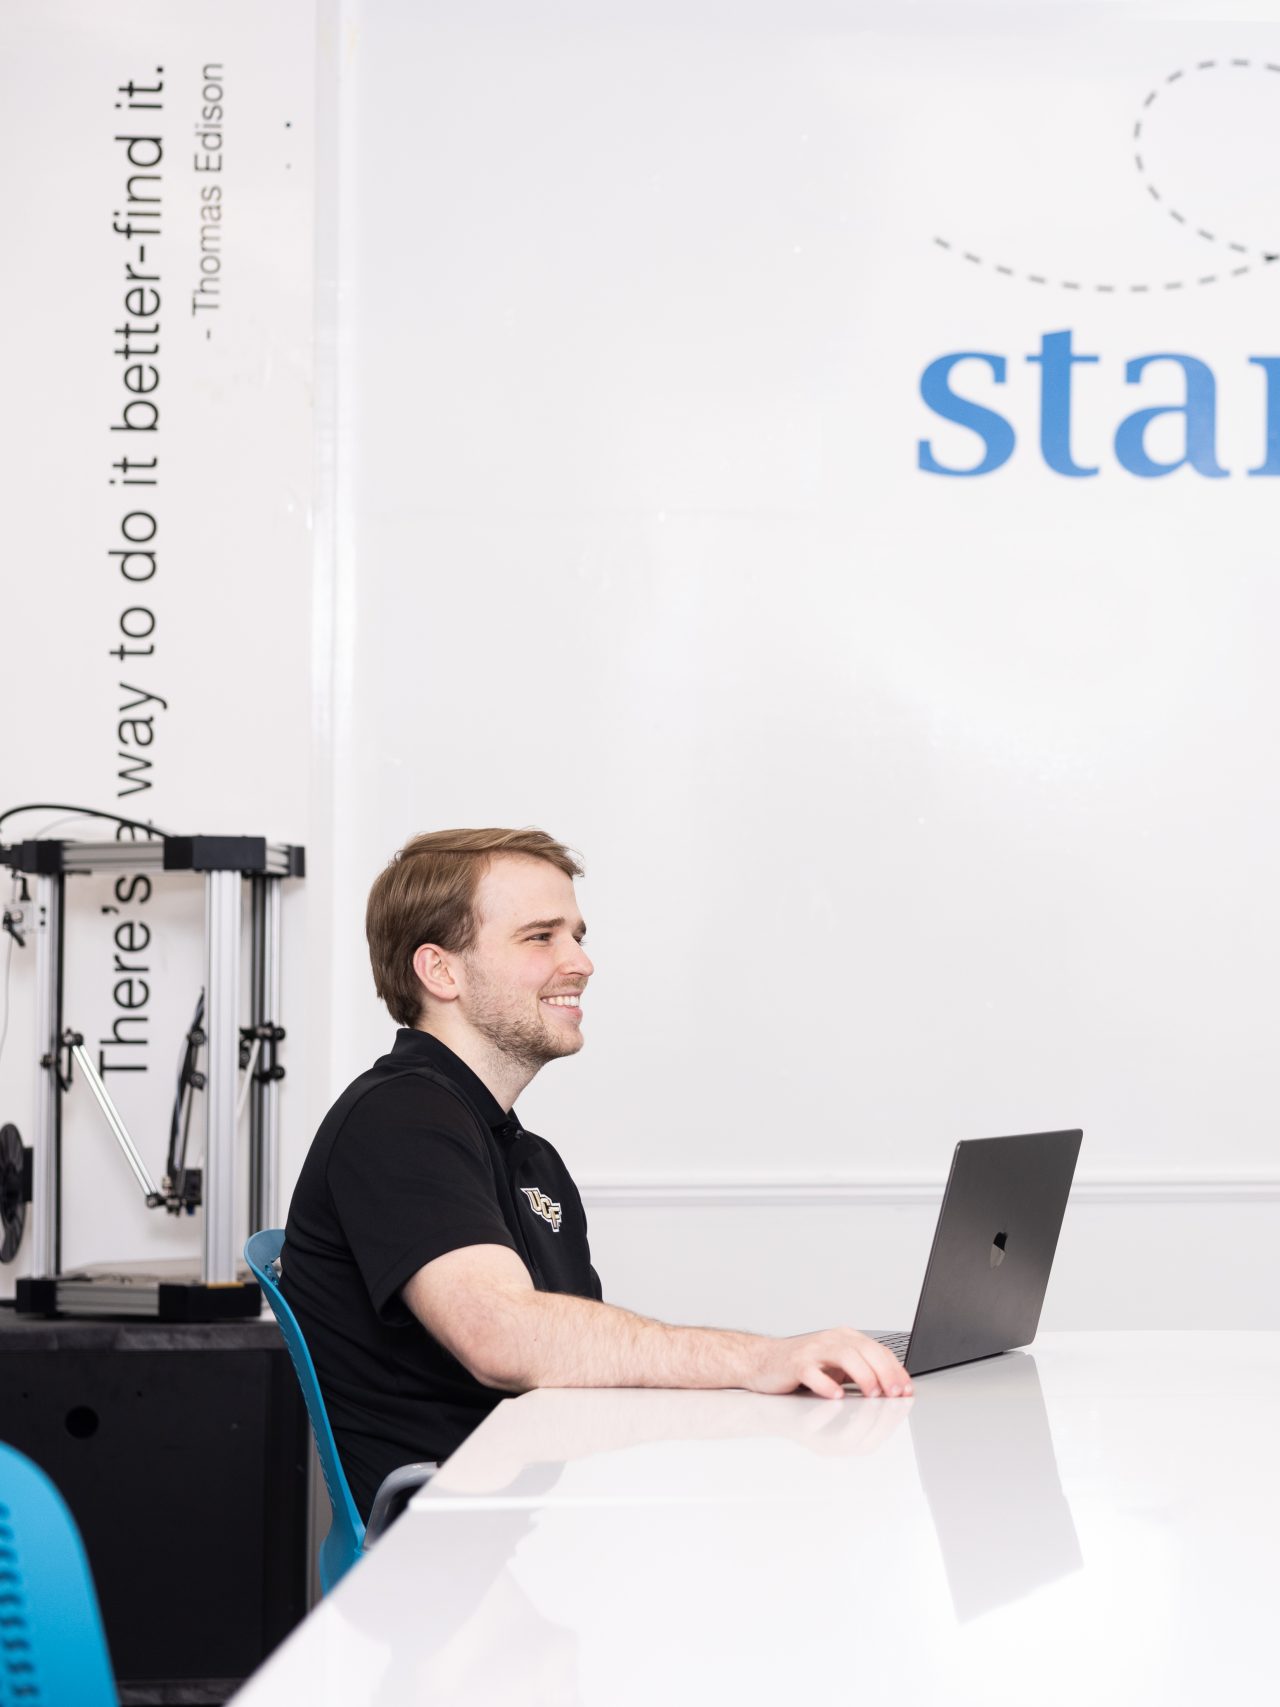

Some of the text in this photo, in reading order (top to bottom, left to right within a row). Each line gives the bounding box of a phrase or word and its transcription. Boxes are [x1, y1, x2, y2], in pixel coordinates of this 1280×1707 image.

[114, 65, 165, 110] it.
[193, 63, 224, 173] Edison
[109, 135, 164, 433] better-find
[191, 185, 223, 317] Thomas
[108, 456, 159, 486] it
[107, 510, 158, 583] do
[108, 605, 157, 662] to
[116, 681, 168, 798] way
[99, 873, 152, 1084] There’s
[520, 1187, 562, 1233] UCF
